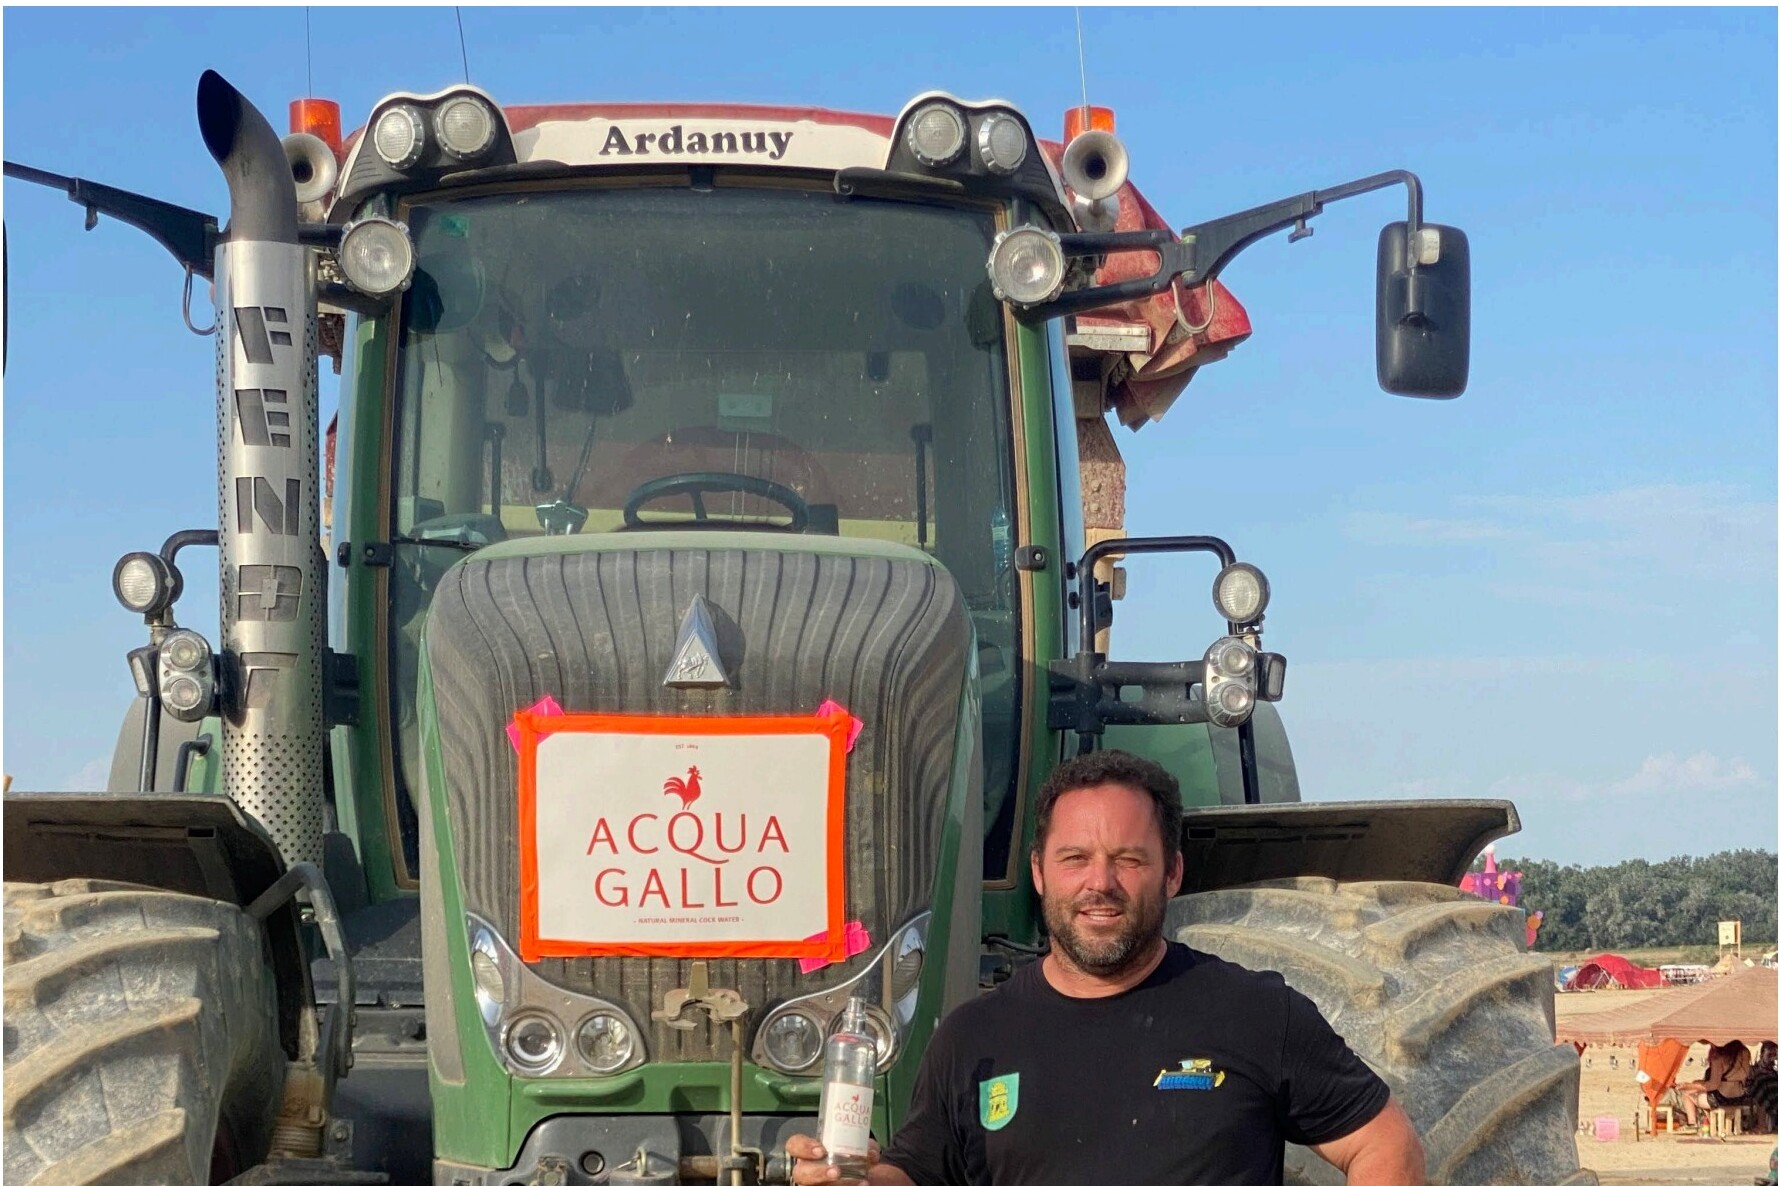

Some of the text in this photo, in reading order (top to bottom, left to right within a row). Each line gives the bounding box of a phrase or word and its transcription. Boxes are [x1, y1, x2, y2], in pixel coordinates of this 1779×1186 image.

[599, 125, 794, 160] Ardanuy
[586, 811, 790, 865] ACQUA
[594, 866, 783, 909] GALLO
